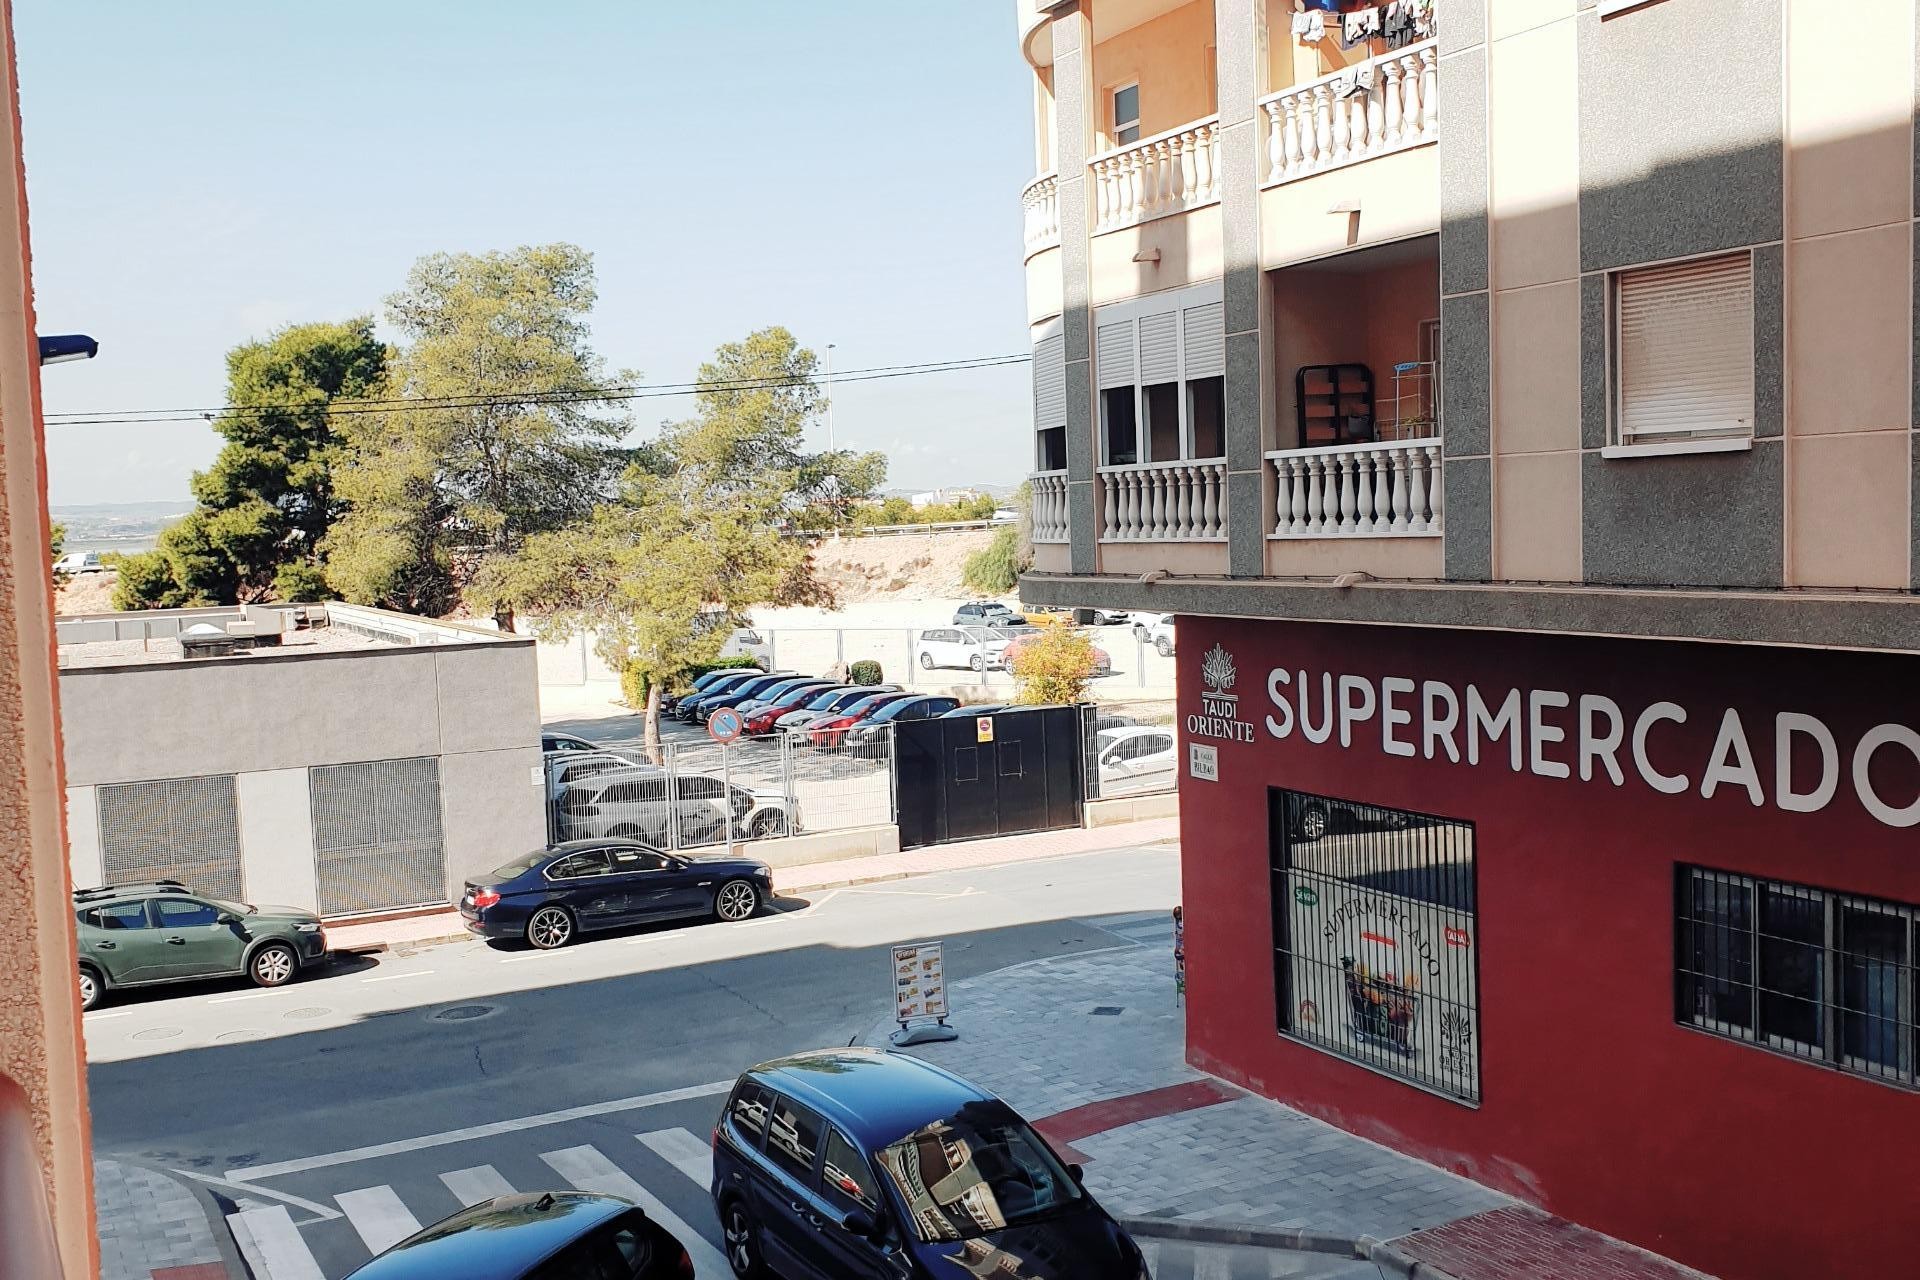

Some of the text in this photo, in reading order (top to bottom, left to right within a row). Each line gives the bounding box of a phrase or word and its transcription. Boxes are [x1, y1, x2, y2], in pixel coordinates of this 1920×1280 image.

[1187, 714, 1255, 743] ORIENTE
[1203, 699, 1237, 719] TAUDI
[1266, 667, 1920, 828] SUPERMERCADO
[1323, 895, 1441, 977] SUPERMERCADO
